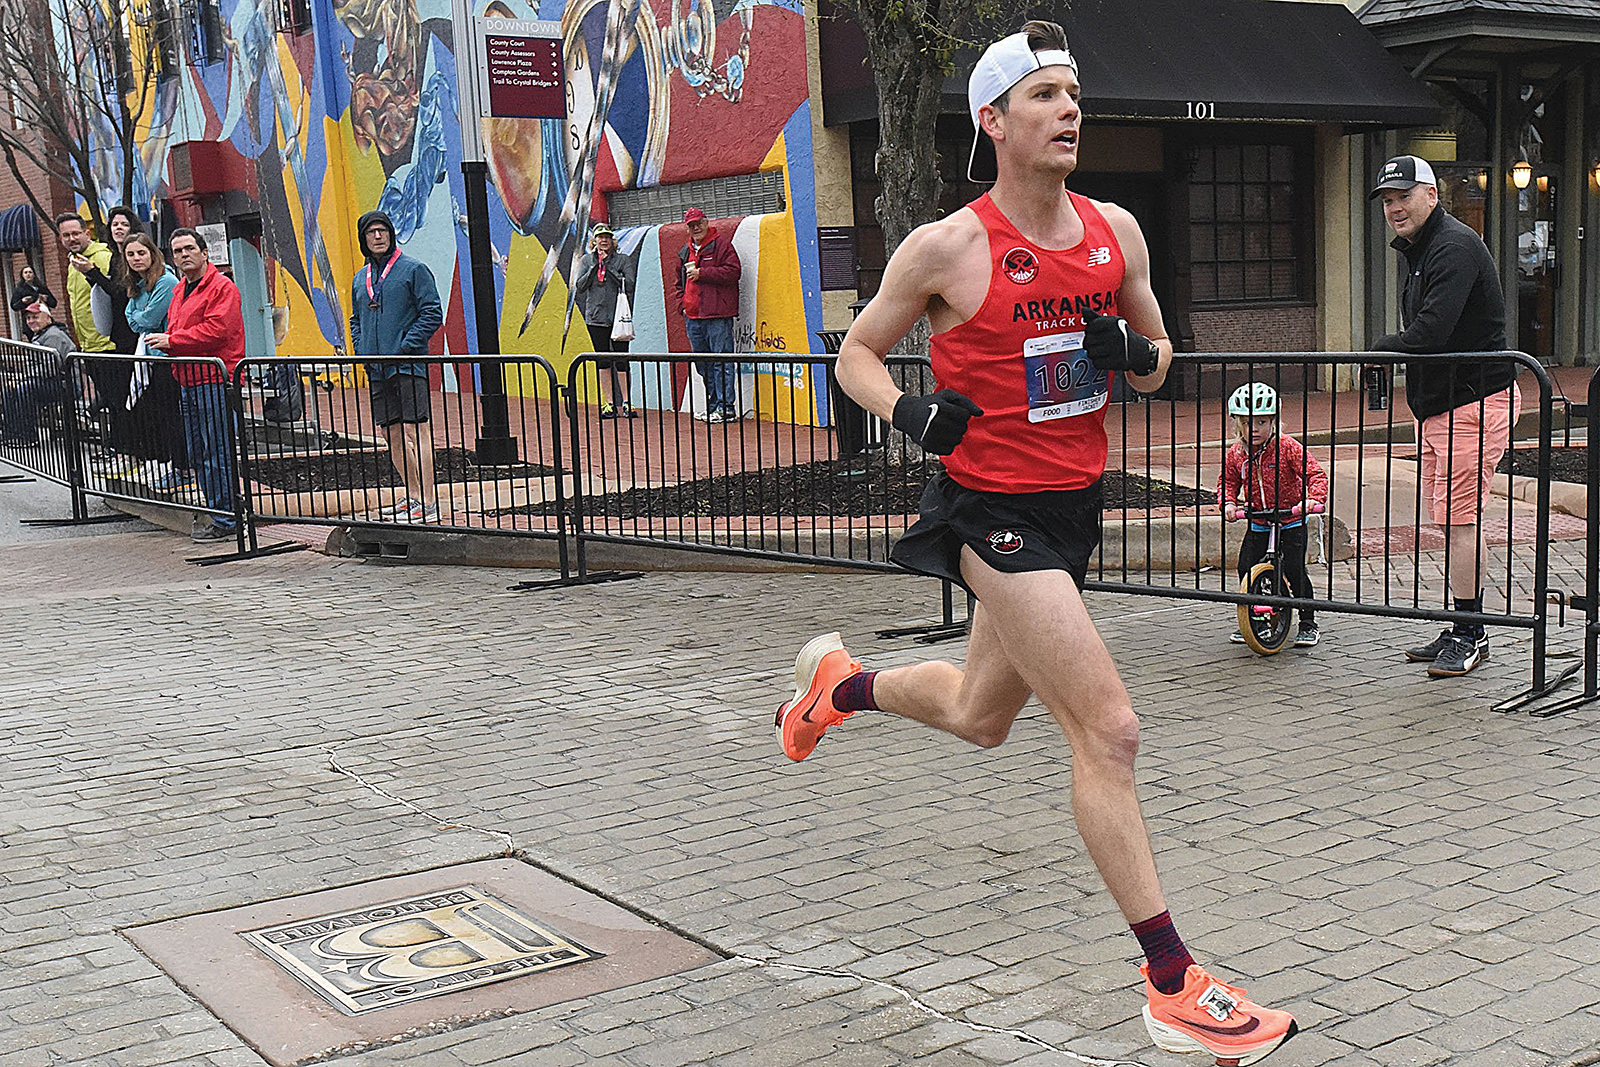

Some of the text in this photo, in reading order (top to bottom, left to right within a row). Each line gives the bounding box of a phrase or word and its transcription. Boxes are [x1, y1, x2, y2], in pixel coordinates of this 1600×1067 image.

[486, 20, 560, 32] DOWNTOWN
[489, 38, 525, 48] County Court
[490, 48, 536, 58] County Assessors
[491, 58, 516, 66] Lawrence
[491, 67, 540, 77] Compton Gardens
[513, 79, 531, 87] Crystal
[532, 79, 552, 88] Bridges
[1186, 101, 1216, 120] 101
[1012, 290, 1113, 323] ARKANSA
[1035, 316, 1076, 331] TRACK
[1042, 407, 1061, 417] FOOD
[262, 893, 472, 941] BENTONVILLE
[372, 951, 562, 1001] THE CITY OF
